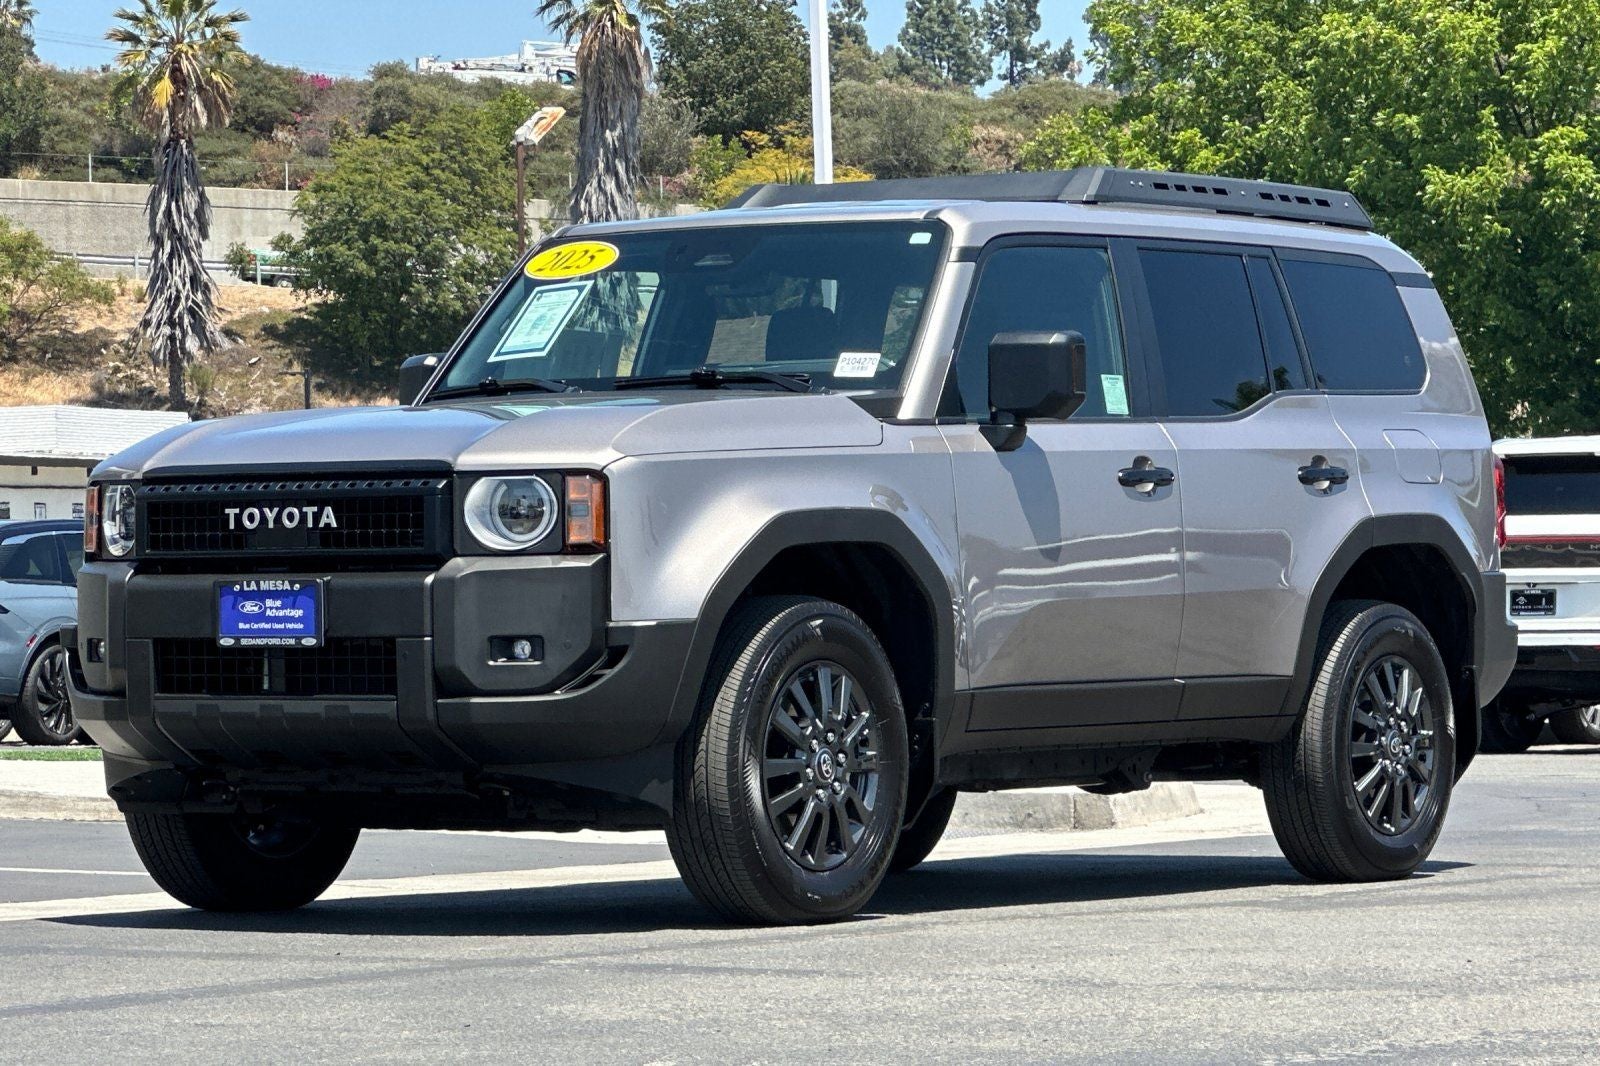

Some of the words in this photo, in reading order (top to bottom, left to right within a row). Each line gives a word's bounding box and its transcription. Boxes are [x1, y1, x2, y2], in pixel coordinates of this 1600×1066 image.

[533, 248, 606, 273] 2025
[224, 506, 337, 529] TOYOTA
[243, 580, 257, 591] LA
[260, 580, 291, 591] MESA
[265, 599, 282, 607] Blue
[265, 608, 304, 618] Advantage
